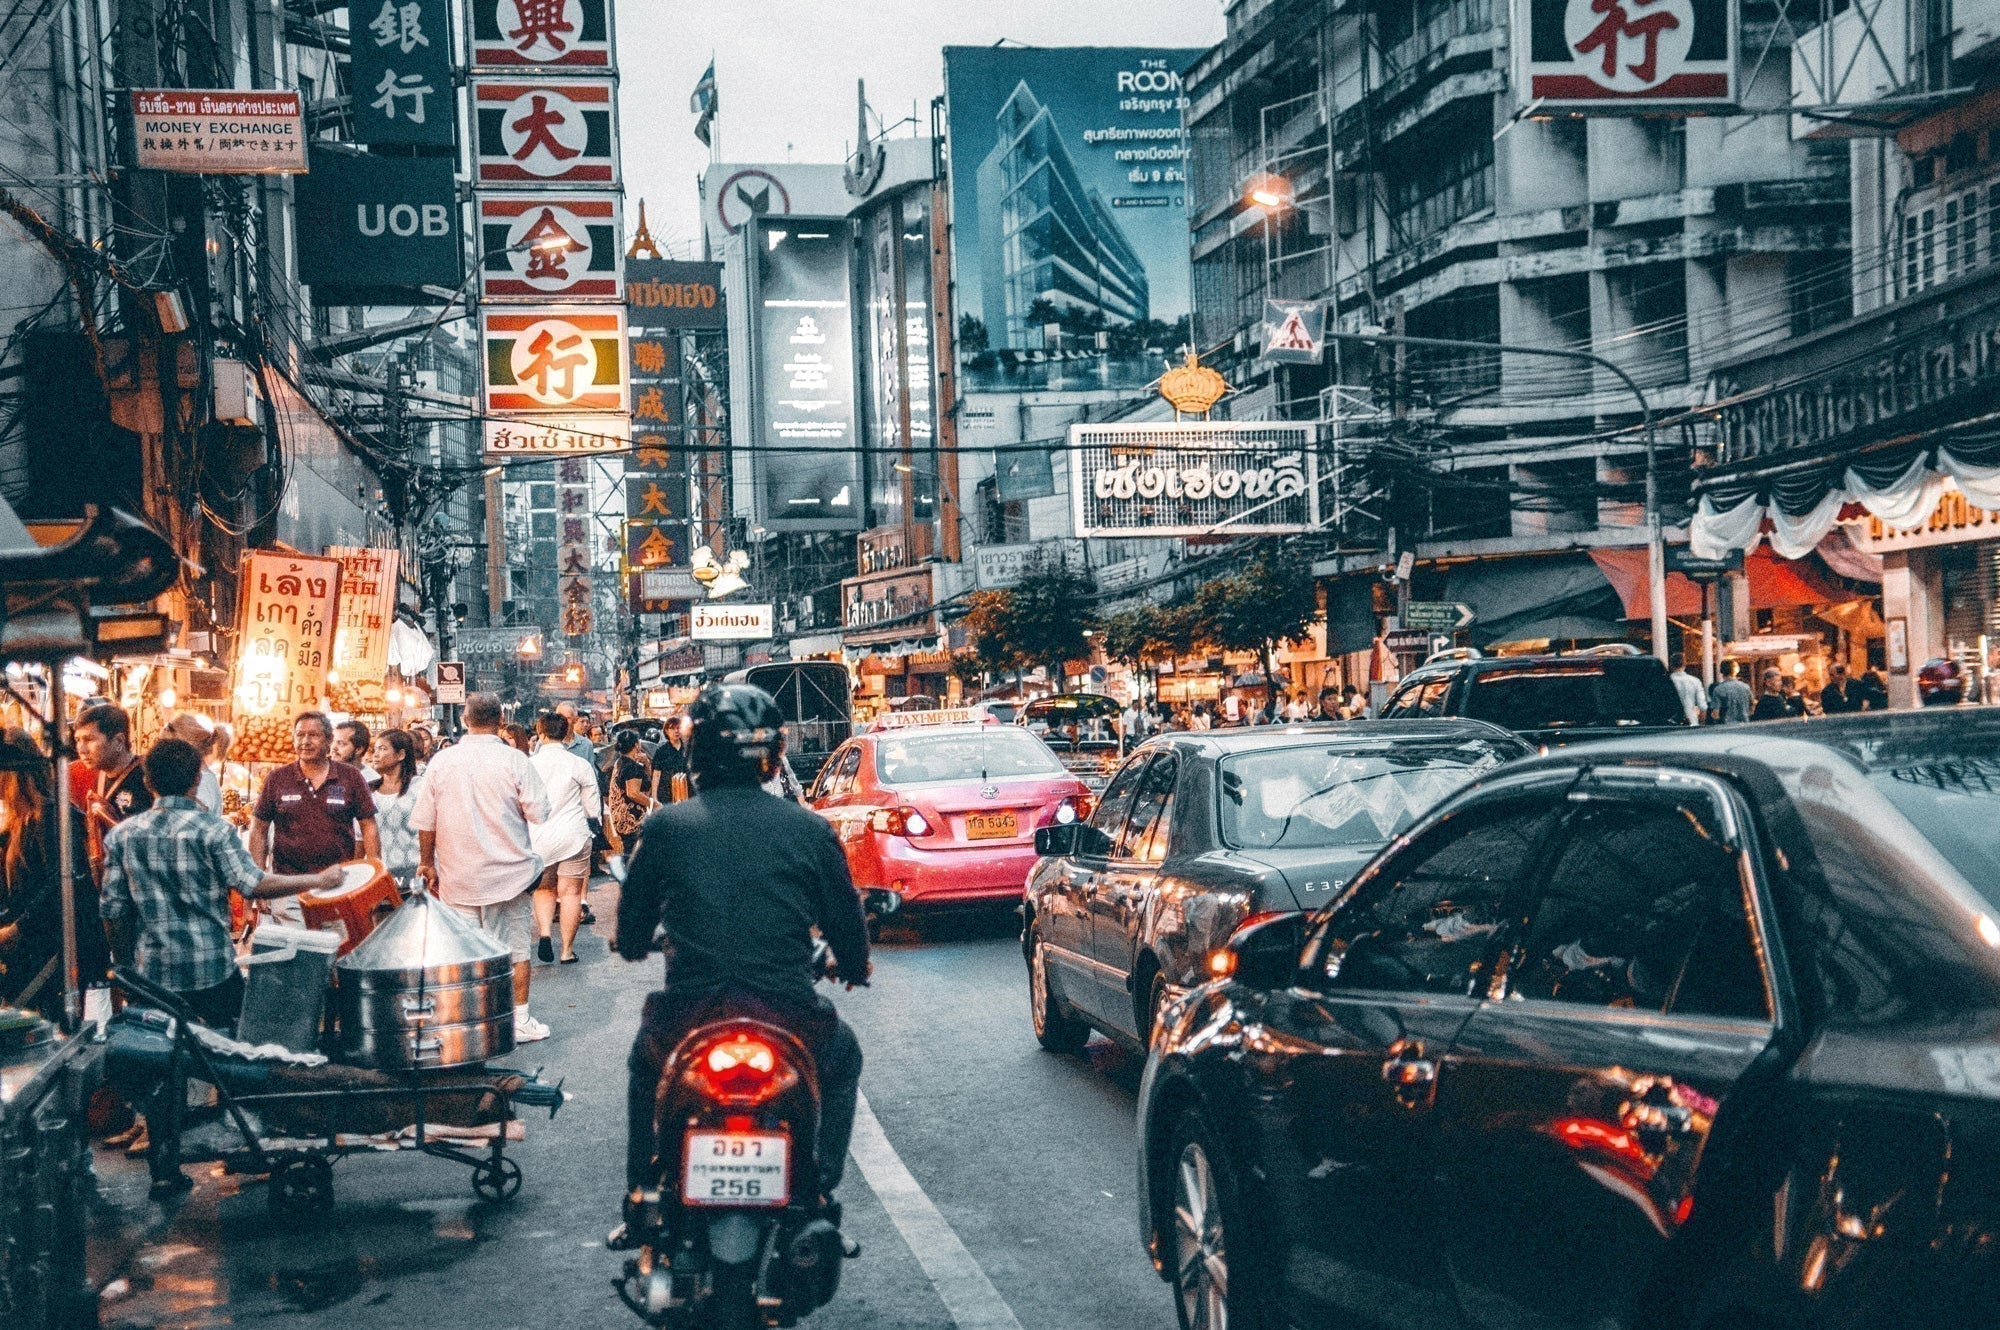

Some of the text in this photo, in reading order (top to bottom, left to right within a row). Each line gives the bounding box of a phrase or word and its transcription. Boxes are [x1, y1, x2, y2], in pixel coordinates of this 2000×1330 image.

[1574, 0, 1679, 83] 行
[1140, 59, 1167, 69] THE
[145, 121, 293, 134] MONEY EXCHANGE
[1151, 169, 1161, 182] 9
[357, 203, 450, 237] UOB
[259, 563, 327, 599] เล้ง
[895, 710, 971, 726] TAXI-METER
[711, 1179, 761, 1196] 256
